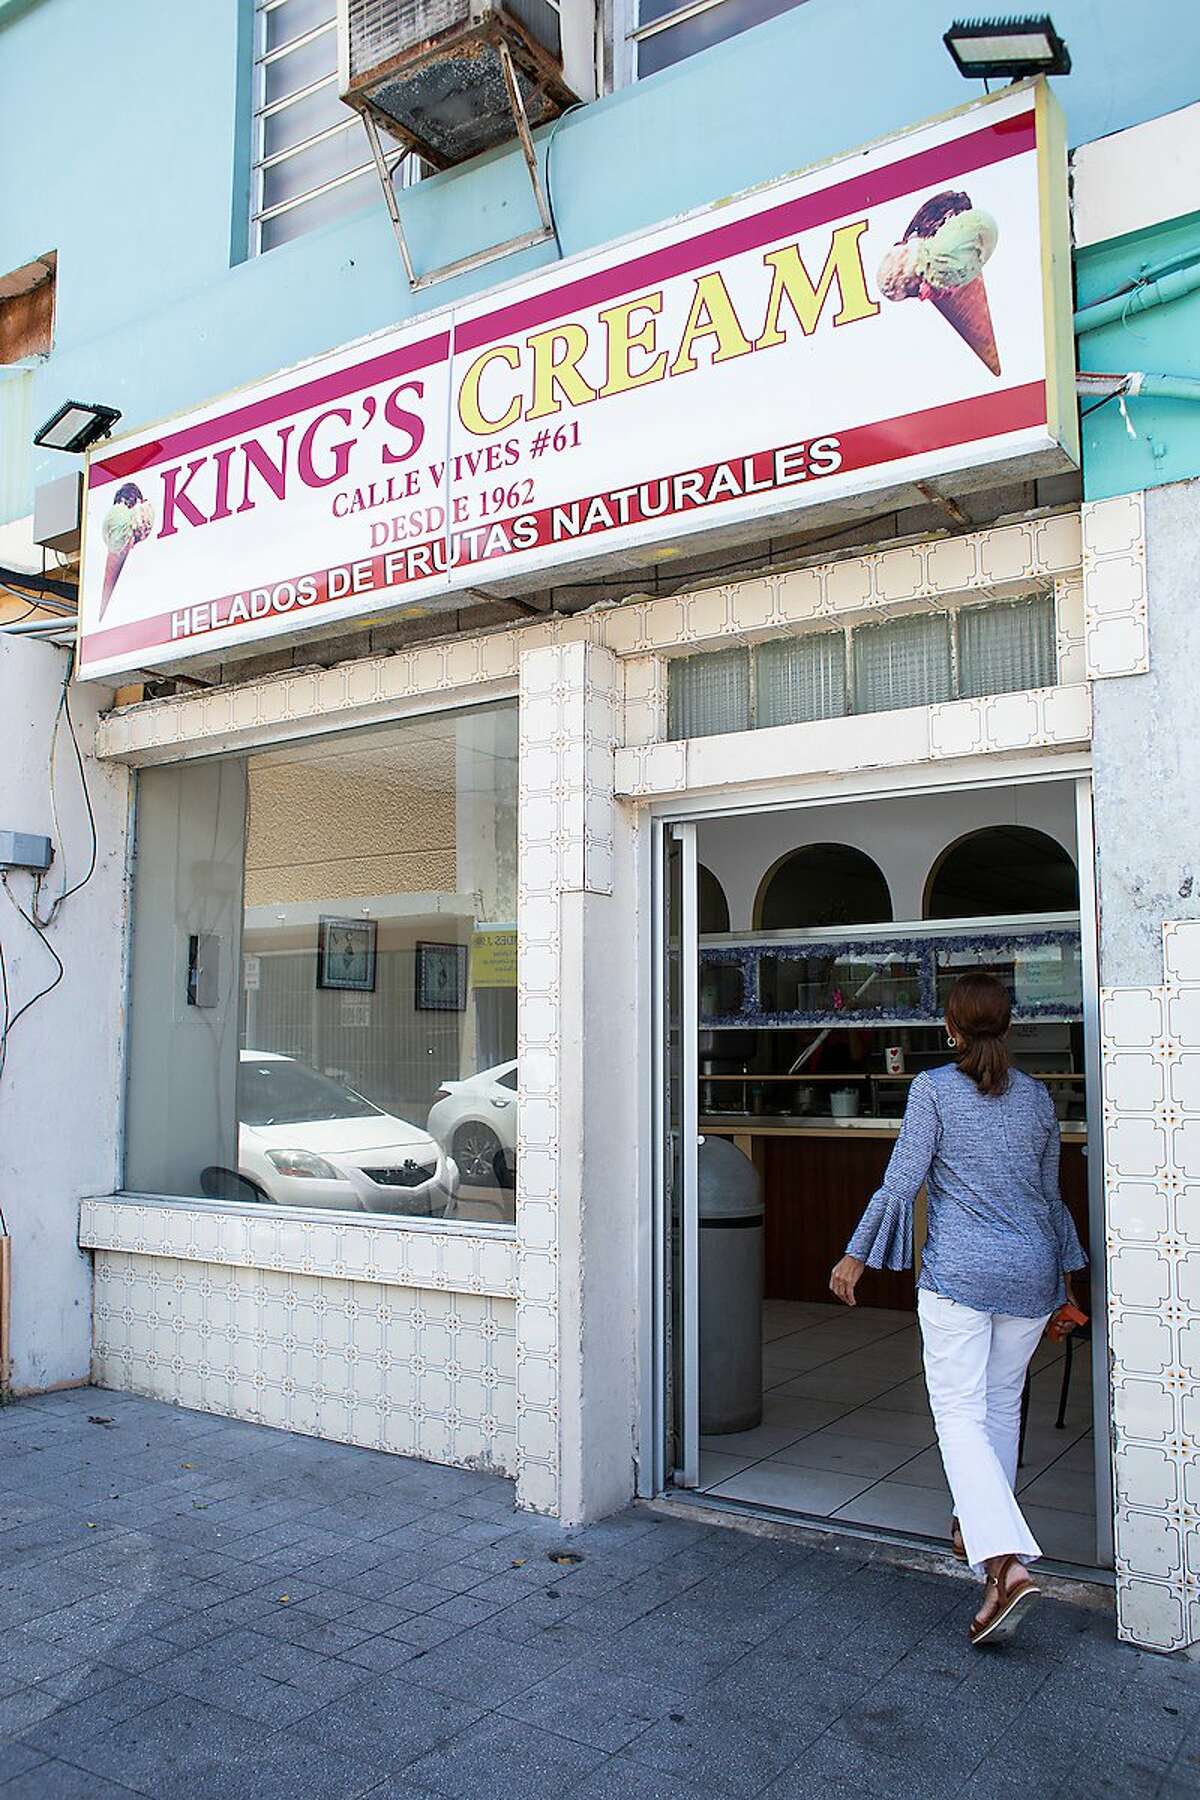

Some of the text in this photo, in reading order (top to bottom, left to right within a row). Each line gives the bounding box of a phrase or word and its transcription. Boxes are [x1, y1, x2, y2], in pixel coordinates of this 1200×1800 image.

[157, 219, 881, 540] KING'S CREAM
[171, 437, 843, 639] HELADOS DE FRUTAS NATURALES
[332, 421, 582, 518] CALLE VIVES #61
[370, 479, 536, 549] DESDE 1962
